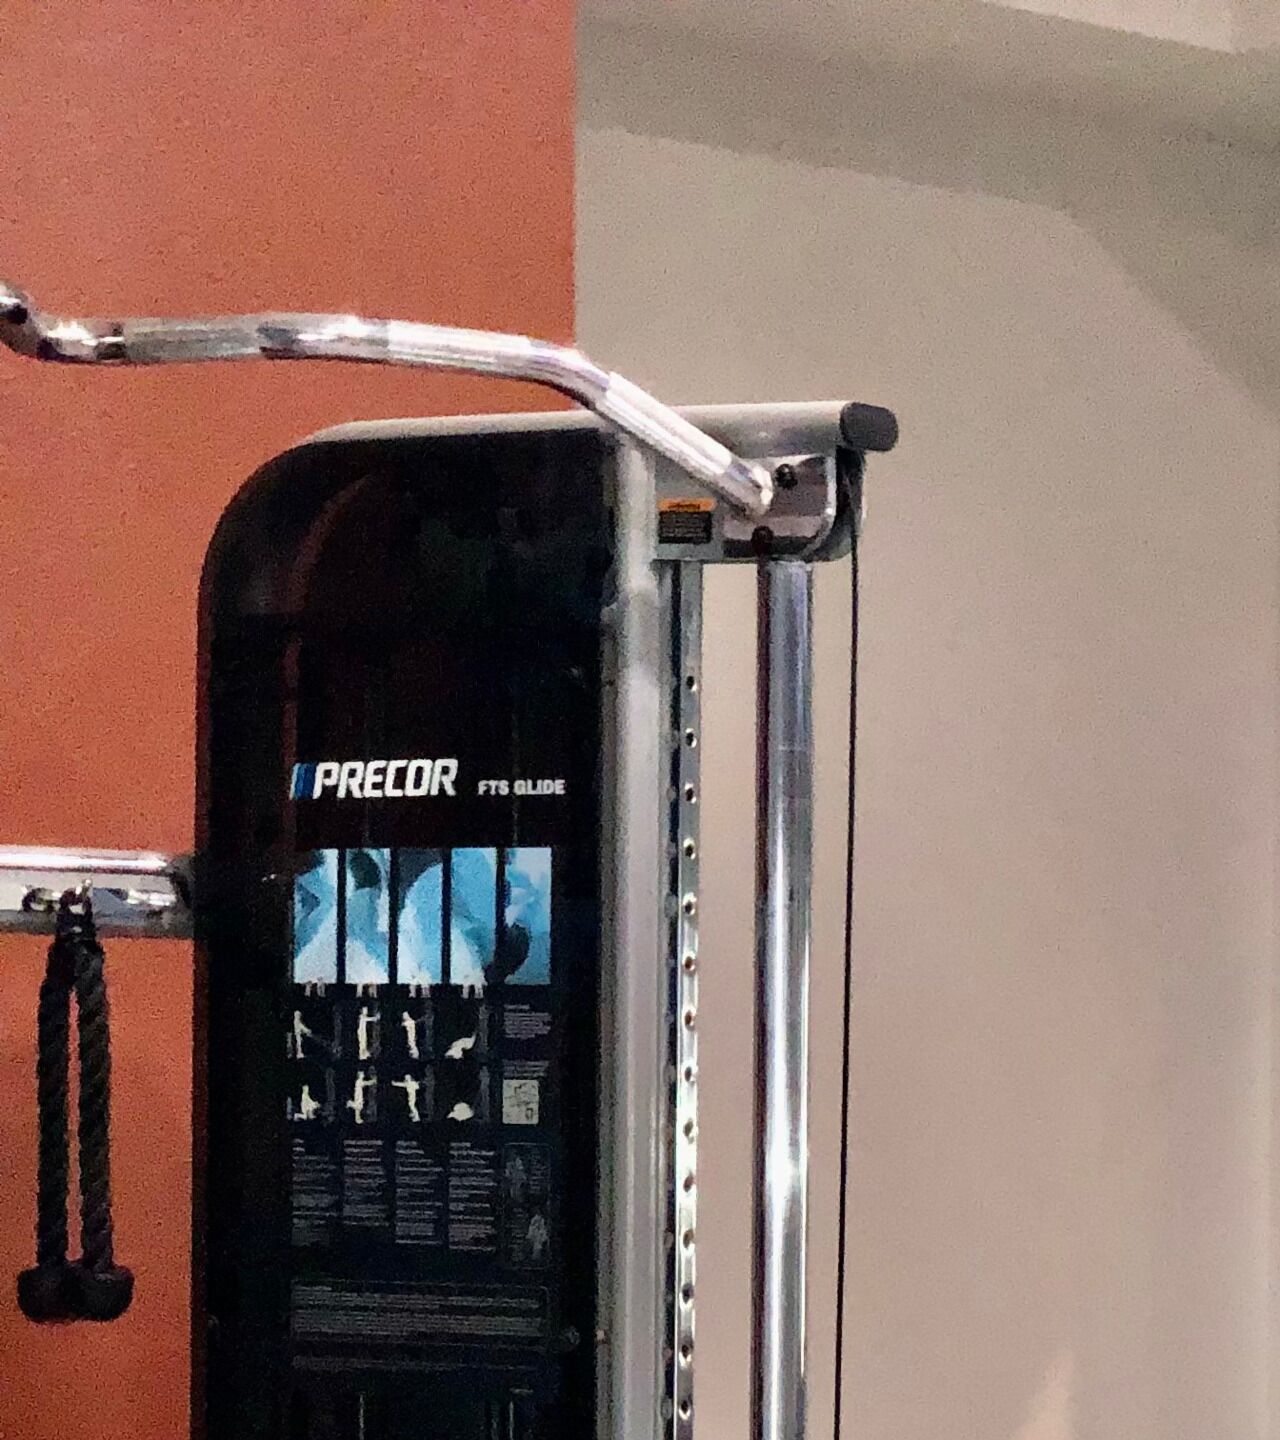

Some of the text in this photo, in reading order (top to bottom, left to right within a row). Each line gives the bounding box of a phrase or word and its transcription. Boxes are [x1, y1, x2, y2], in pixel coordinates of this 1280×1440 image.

[312, 758, 459, 799] PRECOR
[478, 778, 566, 796] FTS GLIDE
